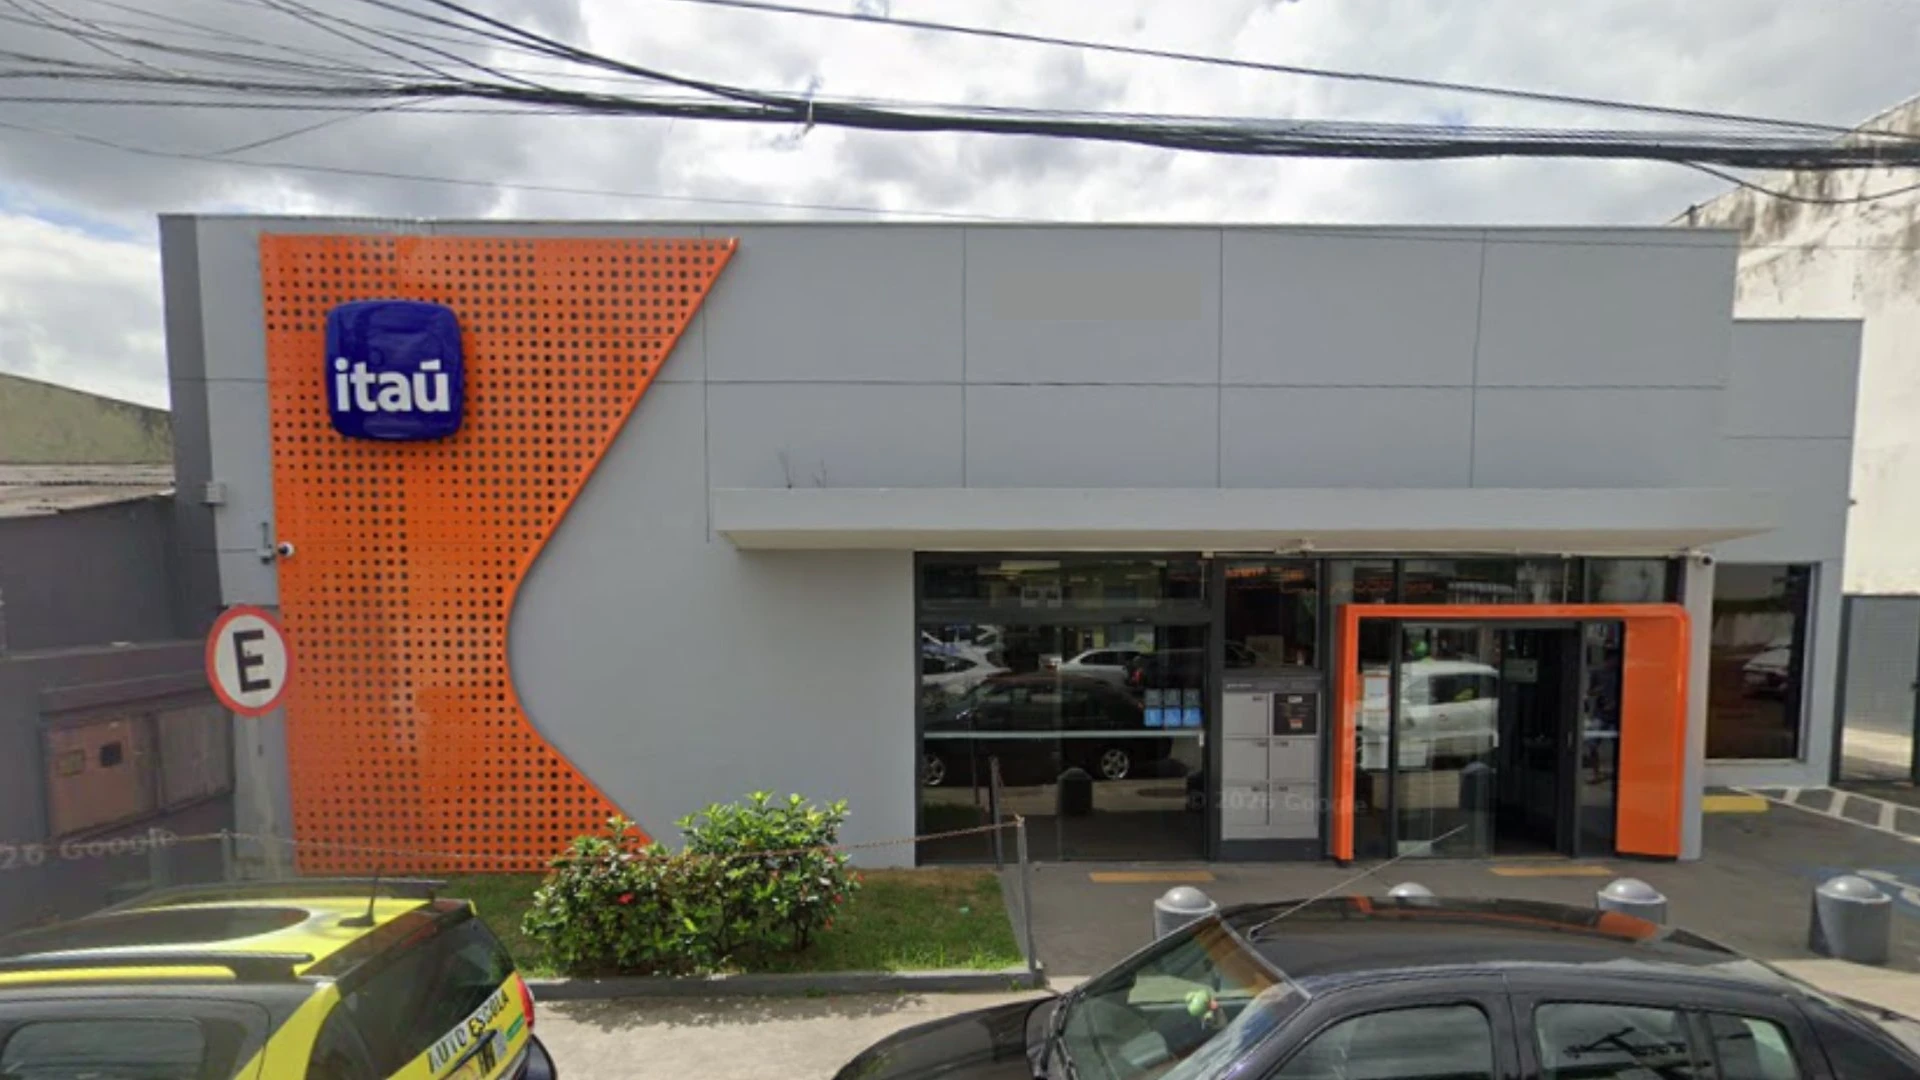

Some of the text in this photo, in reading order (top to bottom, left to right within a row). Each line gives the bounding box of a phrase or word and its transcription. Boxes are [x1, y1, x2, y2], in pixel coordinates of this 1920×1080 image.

[335, 358, 451, 412] itaú
[233, 629, 271, 693] E
[427, 1027, 467, 1074] AUTO
